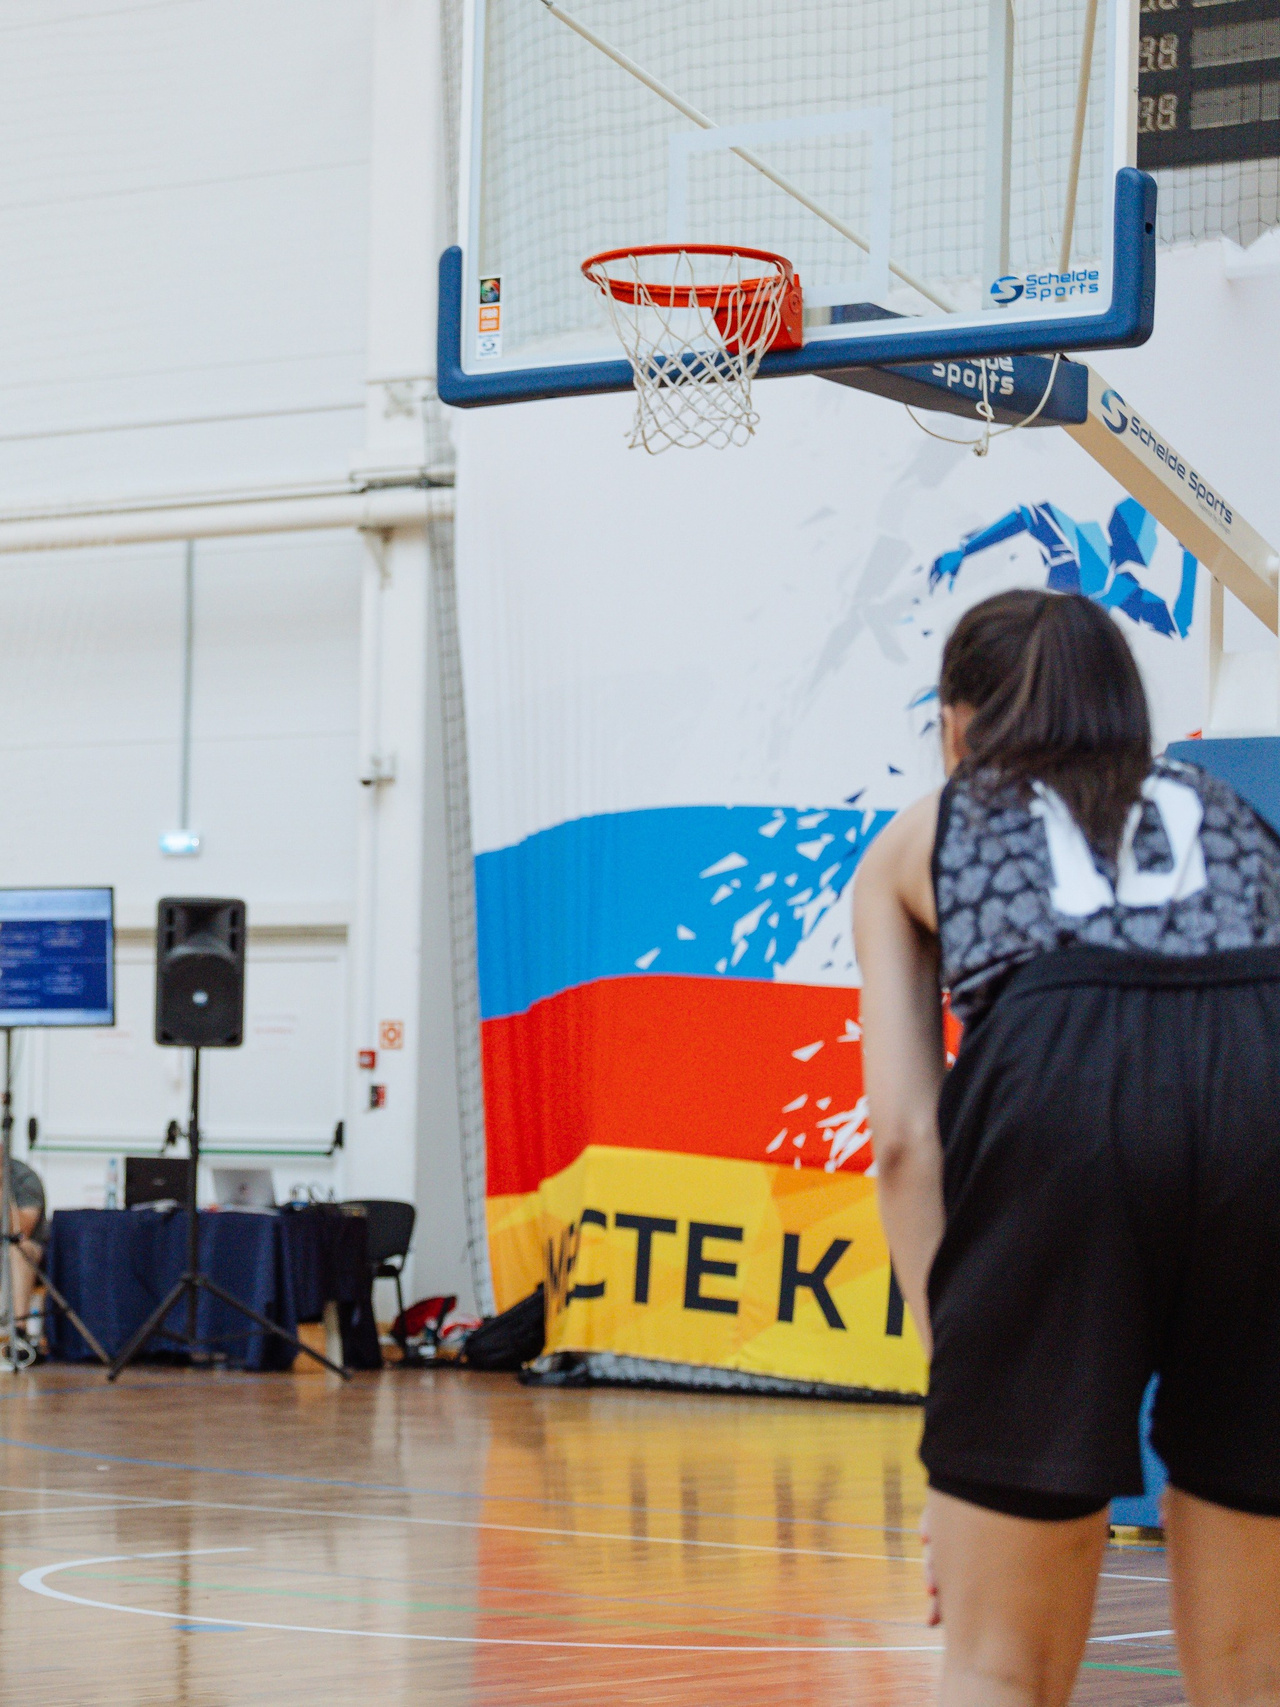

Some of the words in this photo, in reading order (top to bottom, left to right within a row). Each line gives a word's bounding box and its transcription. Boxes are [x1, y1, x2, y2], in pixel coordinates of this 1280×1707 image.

[1025, 269, 1100, 287] Schelde
[1025, 282, 1100, 302] Sports
[1130, 416, 1187, 481] Schelde
[1188, 471, 1233, 525] Sports
